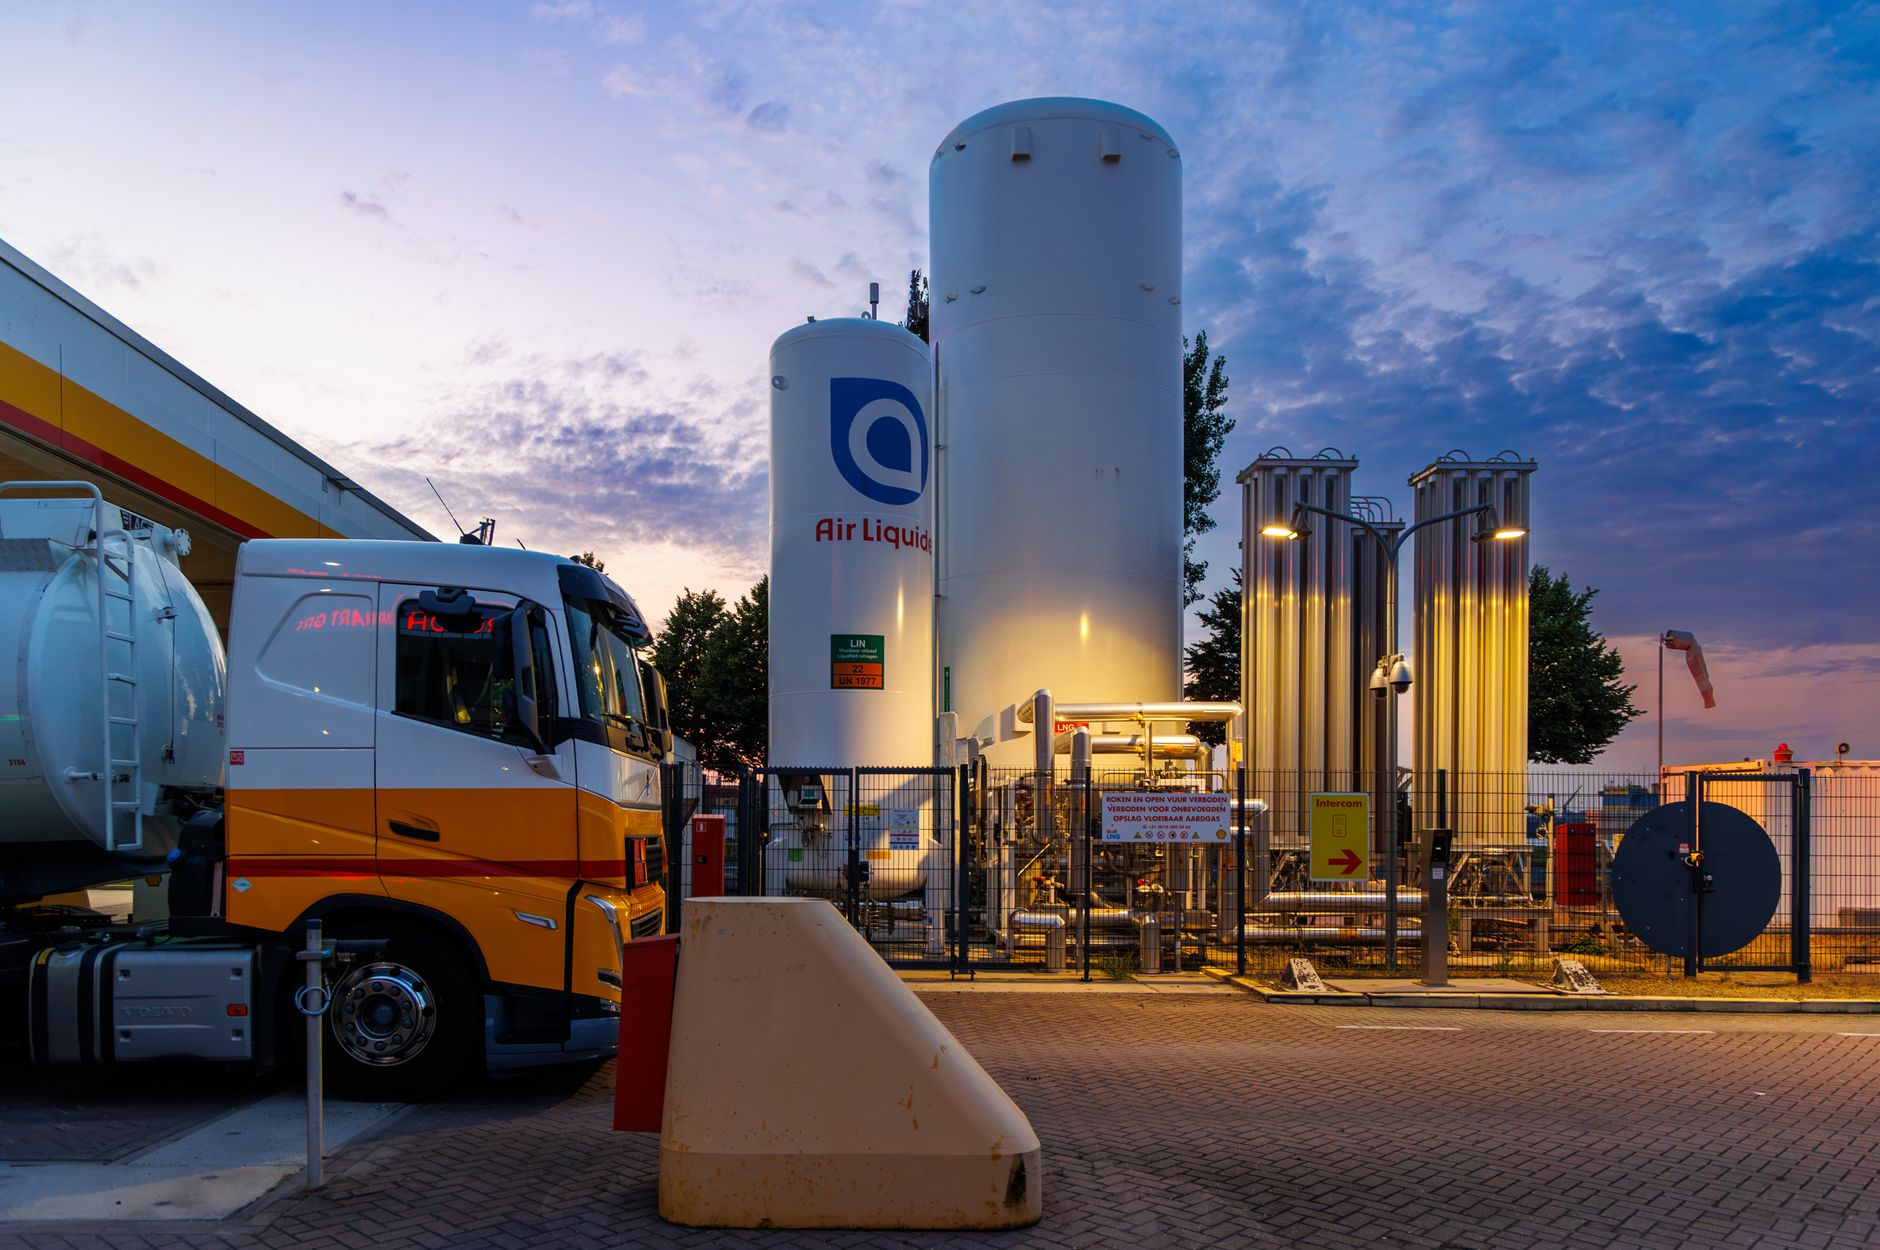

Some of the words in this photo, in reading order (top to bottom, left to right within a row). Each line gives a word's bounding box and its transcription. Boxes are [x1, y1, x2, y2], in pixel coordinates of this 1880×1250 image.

[815, 518, 856, 542] Air
[850, 639, 866, 648] LIN
[852, 664, 864, 673] 22
[839, 677, 852, 685] UN
[856, 677, 876, 686] 1977
[1057, 723, 1075, 731] LNG
[1316, 799, 1363, 808] Intercom
[1171, 805, 1226, 813] ONBEVOEGDEN
[120, 1006, 192, 1017] VOLVO
